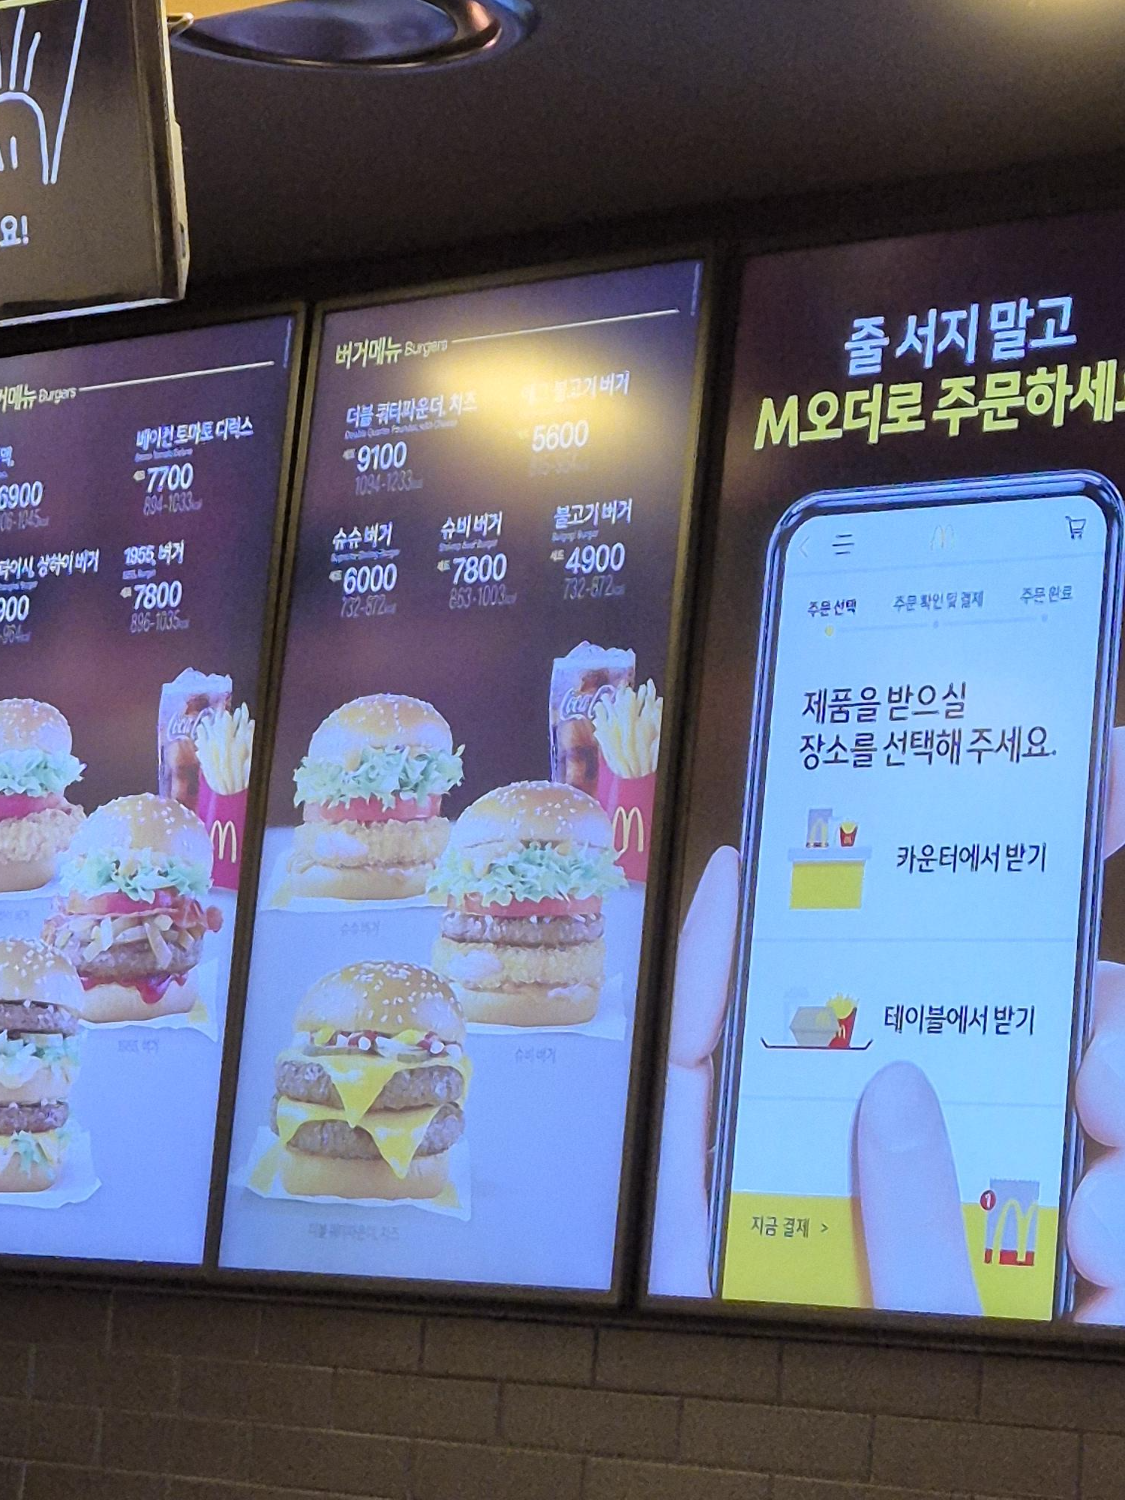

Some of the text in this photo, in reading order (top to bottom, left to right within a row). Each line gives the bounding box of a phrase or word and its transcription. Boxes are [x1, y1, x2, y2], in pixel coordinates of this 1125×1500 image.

[844, 294, 1077, 377] 줄 서지 말고
[335, 336, 403, 370] 버거메뉴
[600, 369, 630, 395] 버거
[346, 403, 373, 428] 더블
[754, 358, 1125, 450] M오더로 주문하세
[531, 419, 589, 452] 5600
[356, 441, 407, 473] 9100
[146, 462, 194, 493] 7700
[440, 510, 503, 540] 슈비 버거
[554, 497, 632, 529] 불고기 버거
[332, 521, 393, 550] 슈슈 버거
[75, 548, 100, 574] 버거
[158, 539, 184, 565] 버거
[564, 542, 626, 574] 4900
[343, 563, 397, 594] 6000
[452, 553, 507, 585] 7800
[134, 580, 183, 610] 7800
[802, 681, 967, 724] 제품을 받으실
[799, 725, 1057, 770] 장소를 선택해 주세요.
[896, 842, 1048, 874] 카운터에서 받기
[884, 1004, 1036, 1035] 테이블에서 받기
[751, 1215, 810, 1238] 지금 결제
